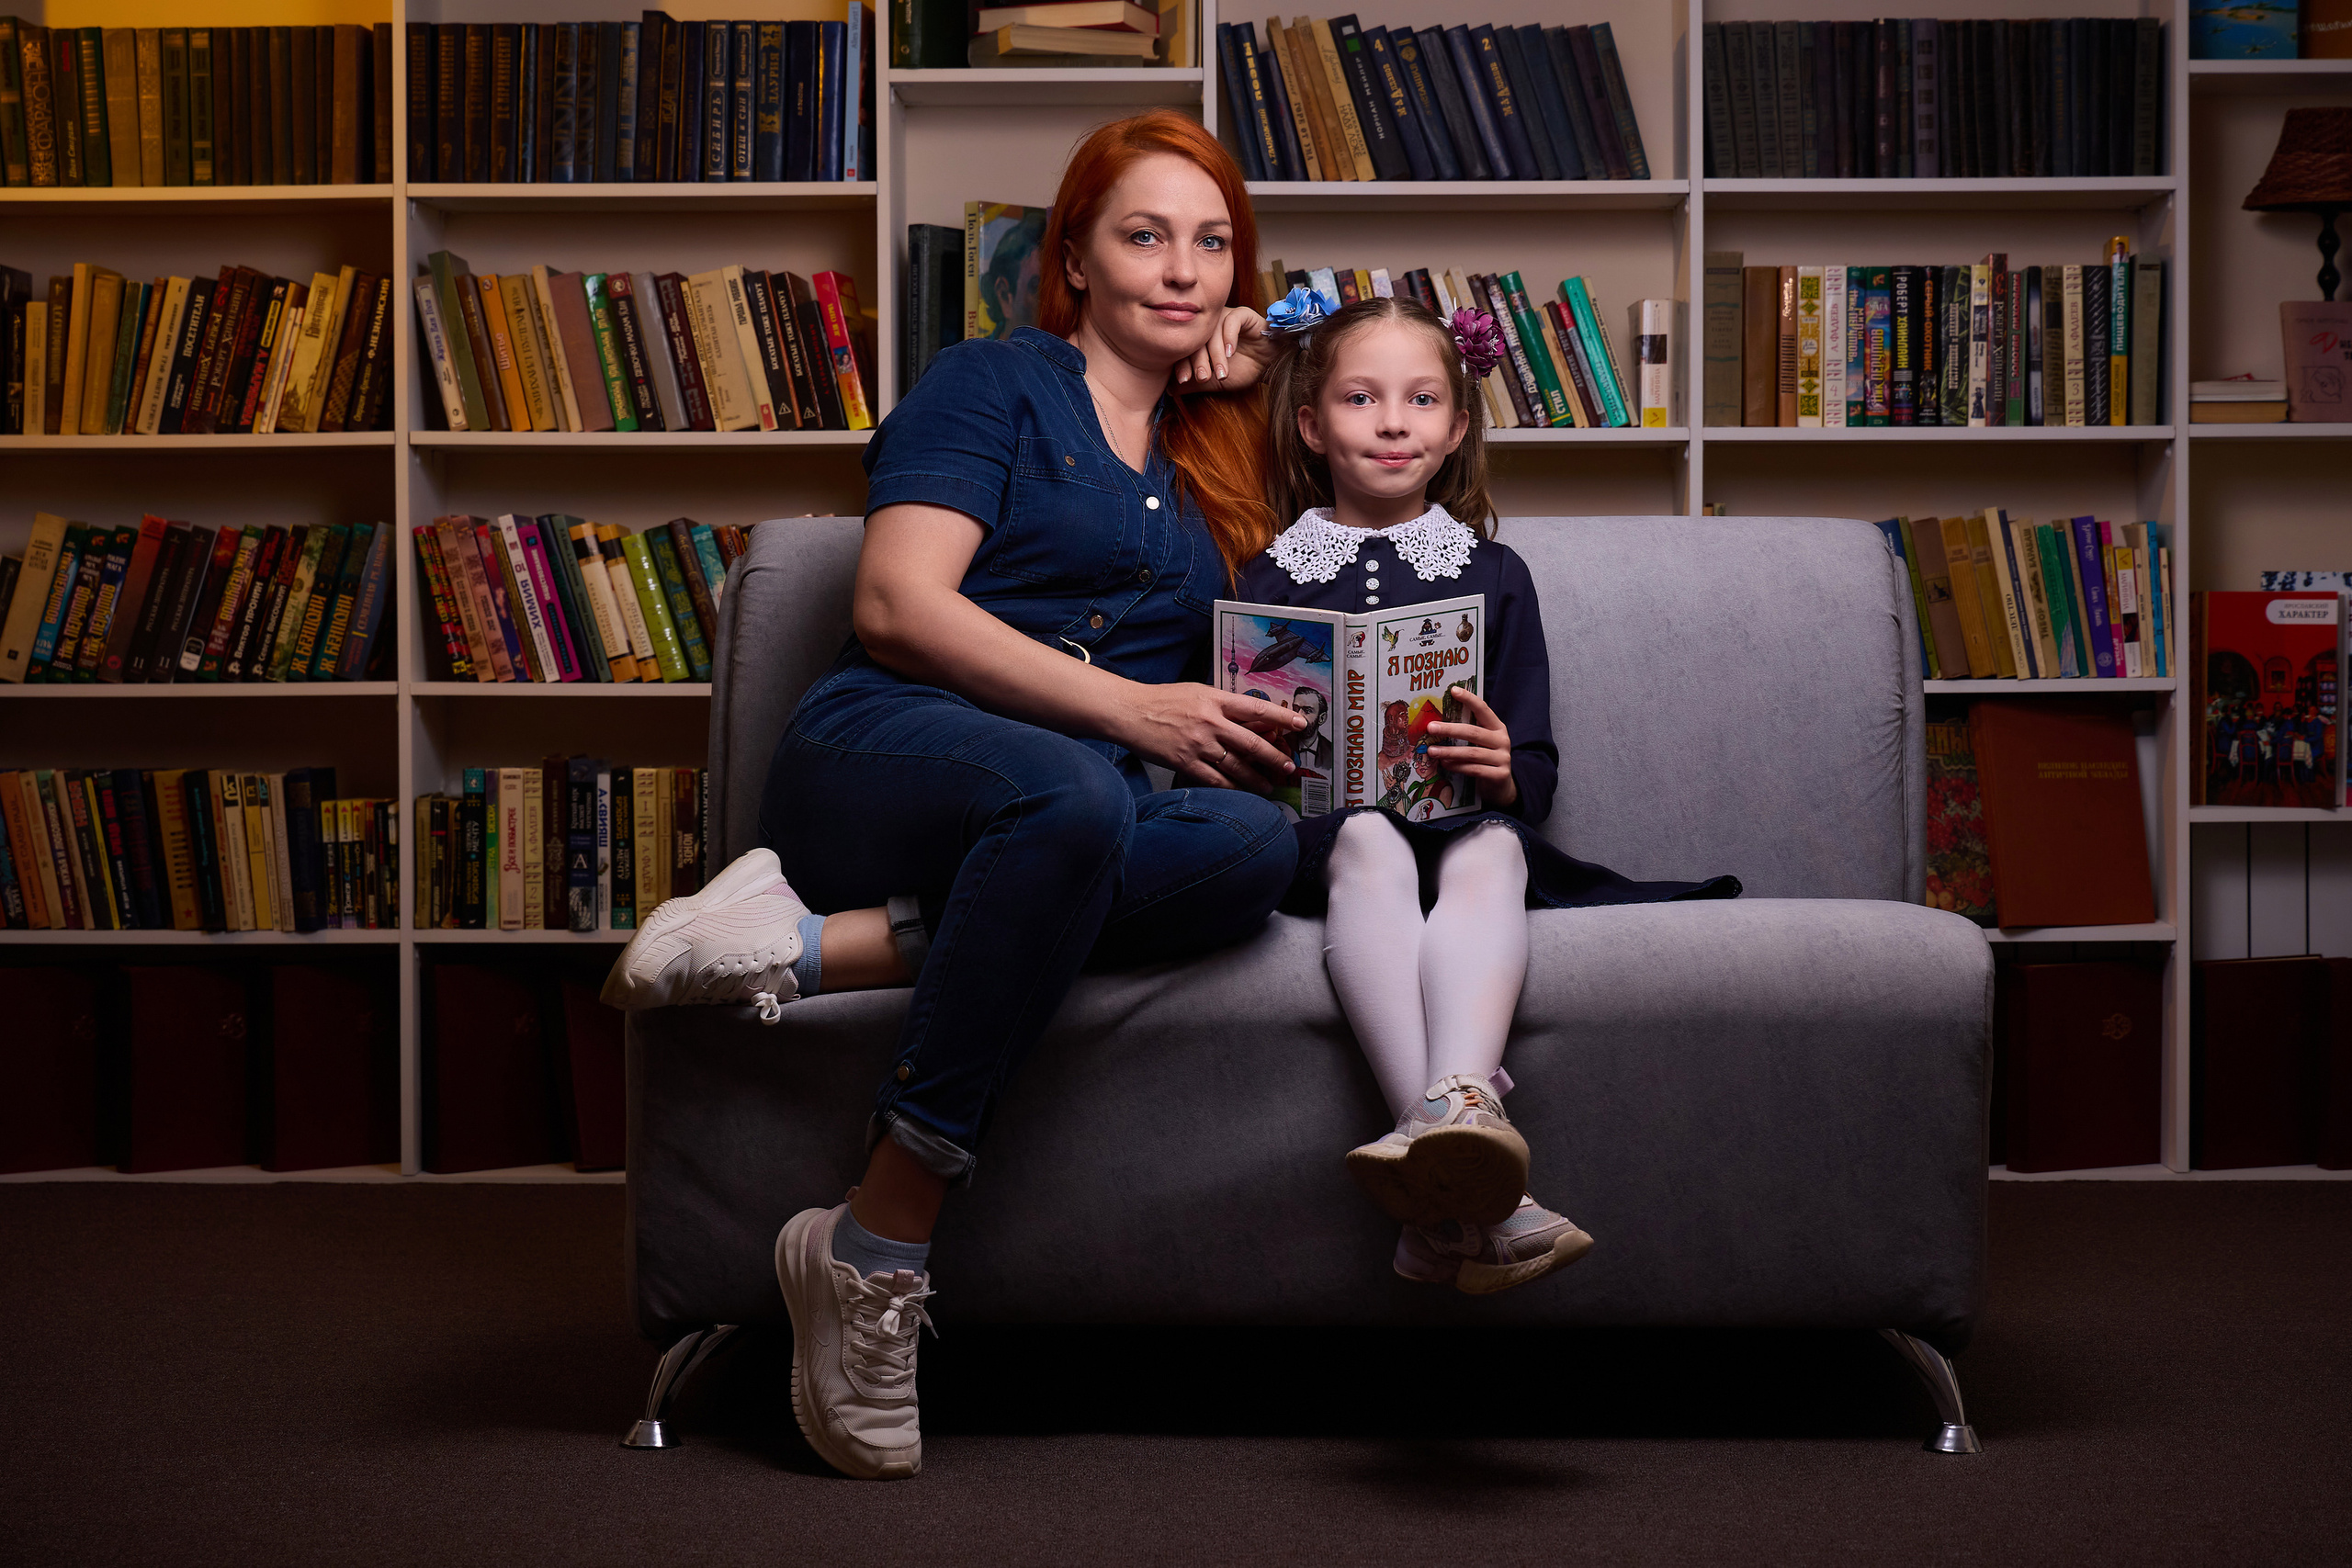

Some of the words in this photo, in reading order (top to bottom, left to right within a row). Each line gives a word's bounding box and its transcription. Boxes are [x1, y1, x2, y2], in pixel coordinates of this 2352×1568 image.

[1374, 38, 1385, 53] 4
[1481, 37, 1493, 51] 2
[768, 52, 780, 105] ДАУРИЯ
[1243, 41, 1263, 101] ПОЭМЫ
[1355, 56, 1372, 96] МЕЙЛЕР
[31, 71, 53, 150] ФАРАОН
[738, 96, 746, 120] СЫН
[1292, 102, 1306, 124] ГОРЕ
[1368, 99, 1385, 140] НОРМАН
[711, 96, 721, 163] СИБИРЬ
[1298, 127, 1307, 139] ОТ
[1339, 104, 1355, 130] НАДЯ
[1348, 130, 1362, 158] ЛЕЖЕ
[738, 135, 746, 163] ОТЕЦ
[1303, 143, 1314, 161] УМА
[967, 246, 977, 277] Гоген
[683, 290, 698, 333] НЕПЛАКУЧАЯ
[753, 282, 768, 313] ПЛАЧУТ
[776, 289, 791, 321] ПЛАЧУТ
[1896, 276, 1907, 314] РОБЕРТ
[2012, 273, 2020, 331] ЛИХОРАДКА
[2116, 265, 2125, 351] ПИЩЕВОДИТЕЛЬ
[182, 294, 206, 357] ПОСЕТИТЕЛИ
[367, 277, 391, 359] Ф.НЕЗНАНСКИЙ
[622, 315, 636, 343] МАДАМ
[762, 314, 772, 335] ТОЖЕ
[784, 321, 796, 343] ТОЖЕ
[1498, 300, 1521, 346] ЛИНДСЕЙ
[1831, 303, 1839, 342] ФАДЕЕВ
[2070, 301, 2079, 341] ФАДЕЕВ
[495, 333, 512, 370] Шитье
[694, 333, 706, 363] ИВУШКА
[766, 336, 780, 370] БОГАТЫЕ
[789, 343, 804, 377] БОГАТЫЕ
[1871, 328, 1883, 381] ПЕРУМОВ
[1896, 315, 1908, 368] ХАЙНЛАЙН
[2011, 334, 2019, 378] ЗОЛОТАЯ
[629, 344, 644, 378] ДЕВОЧКИ
[1517, 349, 1538, 394] ДЖОАННА
[1566, 353, 1585, 388] АВАРСКИЕ
[1949, 344, 1959, 389] ПРЕСТУПЛЕНИЕ
[239, 365, 266, 426] МАРИНИНА
[1550, 389, 1566, 415] СТИЛ
[63, 585, 92, 637] ПЕРУМОВ
[88, 582, 117, 636] ПЕРУМОВ
[243, 581, 264, 623] ПРОНИН
[520, 579, 542, 629] ХИМИЯ
[2005, 593, 2018, 631] ДЕТСТВО
[2278, 611, 2329, 619] ХАРАКТЕР
[2037, 608, 2050, 639] ТИБОР
[1387, 656, 1400, 676] Я
[1404, 647, 1469, 674] ПОЗНАЮ
[1409, 669, 1445, 692] МИР
[1347, 669, 1366, 711] МИР
[1347, 714, 1365, 795] ПОЗНАЮ
[528, 807, 538, 844] ФАДЕЕВ
[684, 832, 694, 863] ЗОНОЙ
